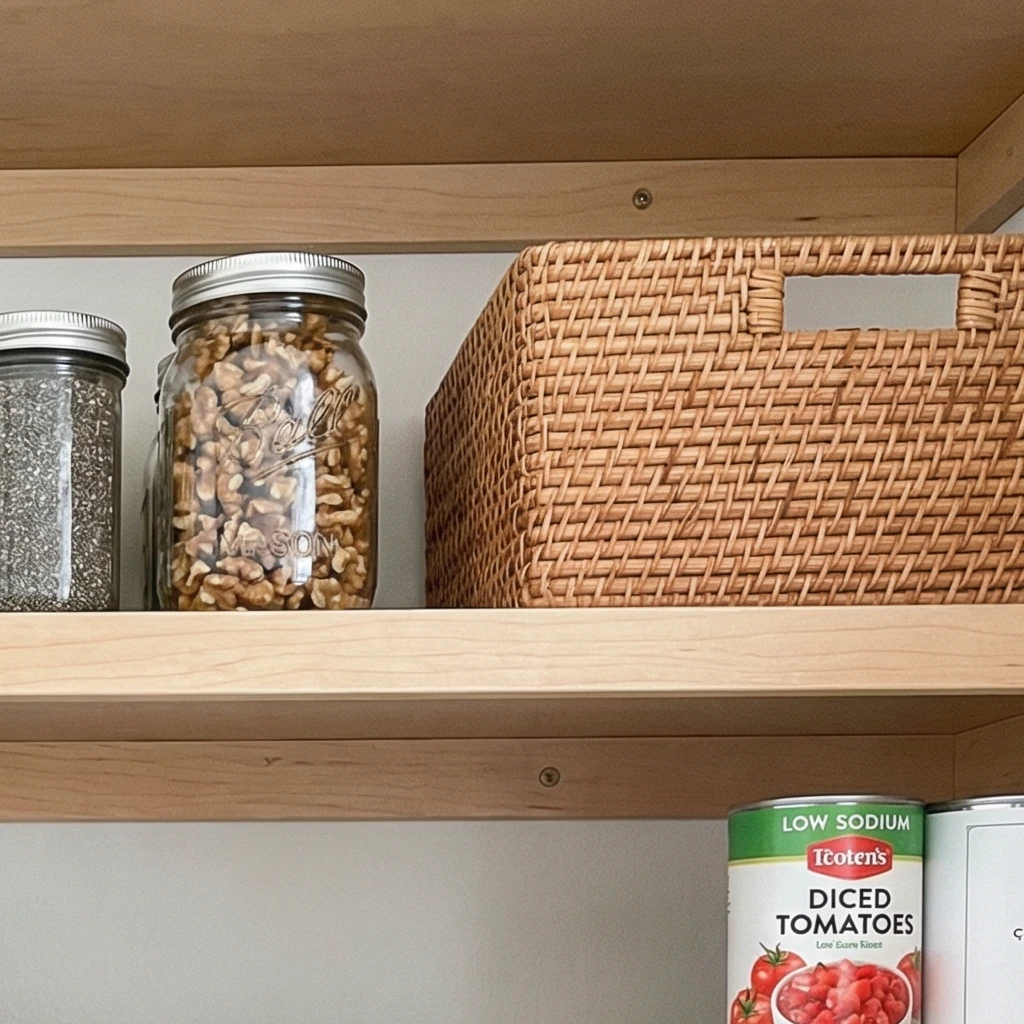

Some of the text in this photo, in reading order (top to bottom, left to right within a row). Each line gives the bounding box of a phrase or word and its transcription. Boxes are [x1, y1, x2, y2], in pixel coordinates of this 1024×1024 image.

[782, 813, 911, 832] LOW SODIUM
[809, 888, 892, 910] DICED
[775, 913, 915, 936] TOMATOES
